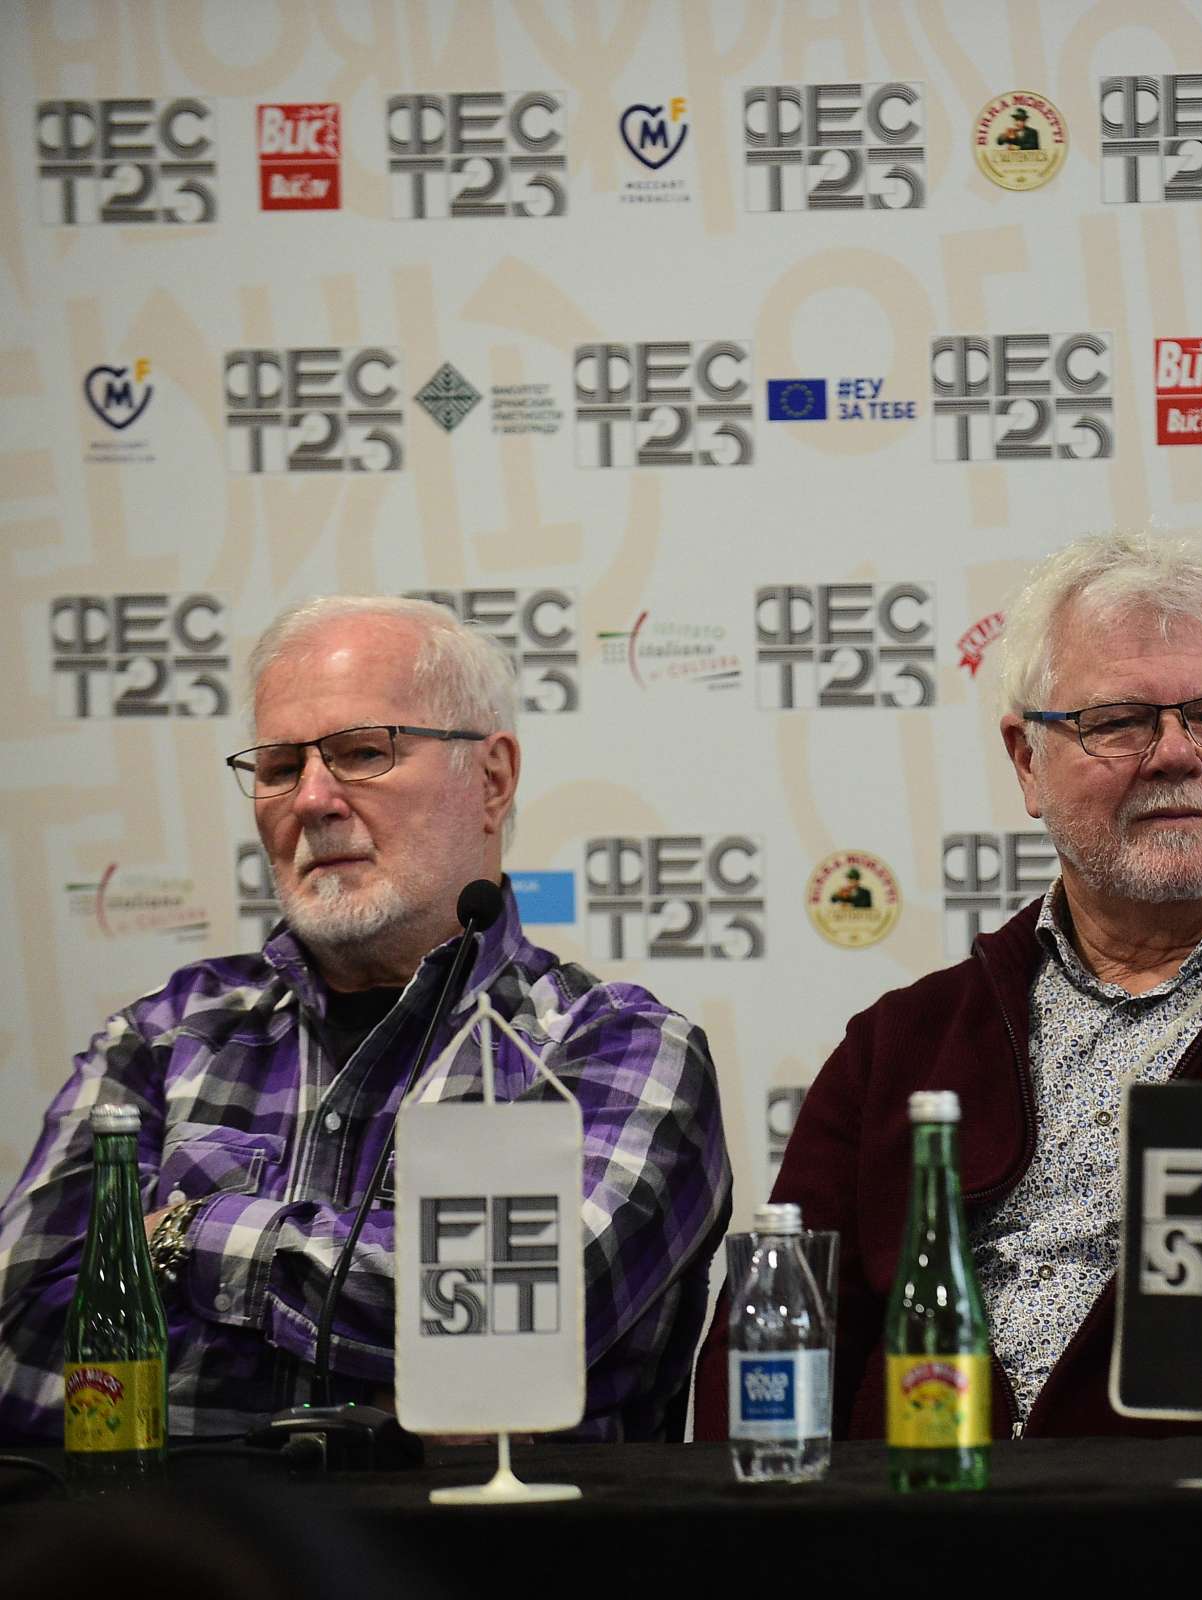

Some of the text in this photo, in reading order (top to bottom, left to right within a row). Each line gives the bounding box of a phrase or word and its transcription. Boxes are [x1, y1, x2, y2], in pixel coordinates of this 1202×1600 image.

[38, 99, 215, 160] ФЕС
[387, 92, 566, 155] ФЕС
[744, 84, 924, 147] ФЕС
[224, 348, 402, 409] ФЕС
[574, 342, 753, 404] ФЕС
[932, 334, 1112, 397] ФЕС
[868, 401, 916, 420] ТЕБЕ
[51, 595, 229, 654] ФЕС
[403, 588, 573, 649] ЕС
[756, 584, 935, 645] ФЕС
[586, 837, 764, 896] ФЕС
